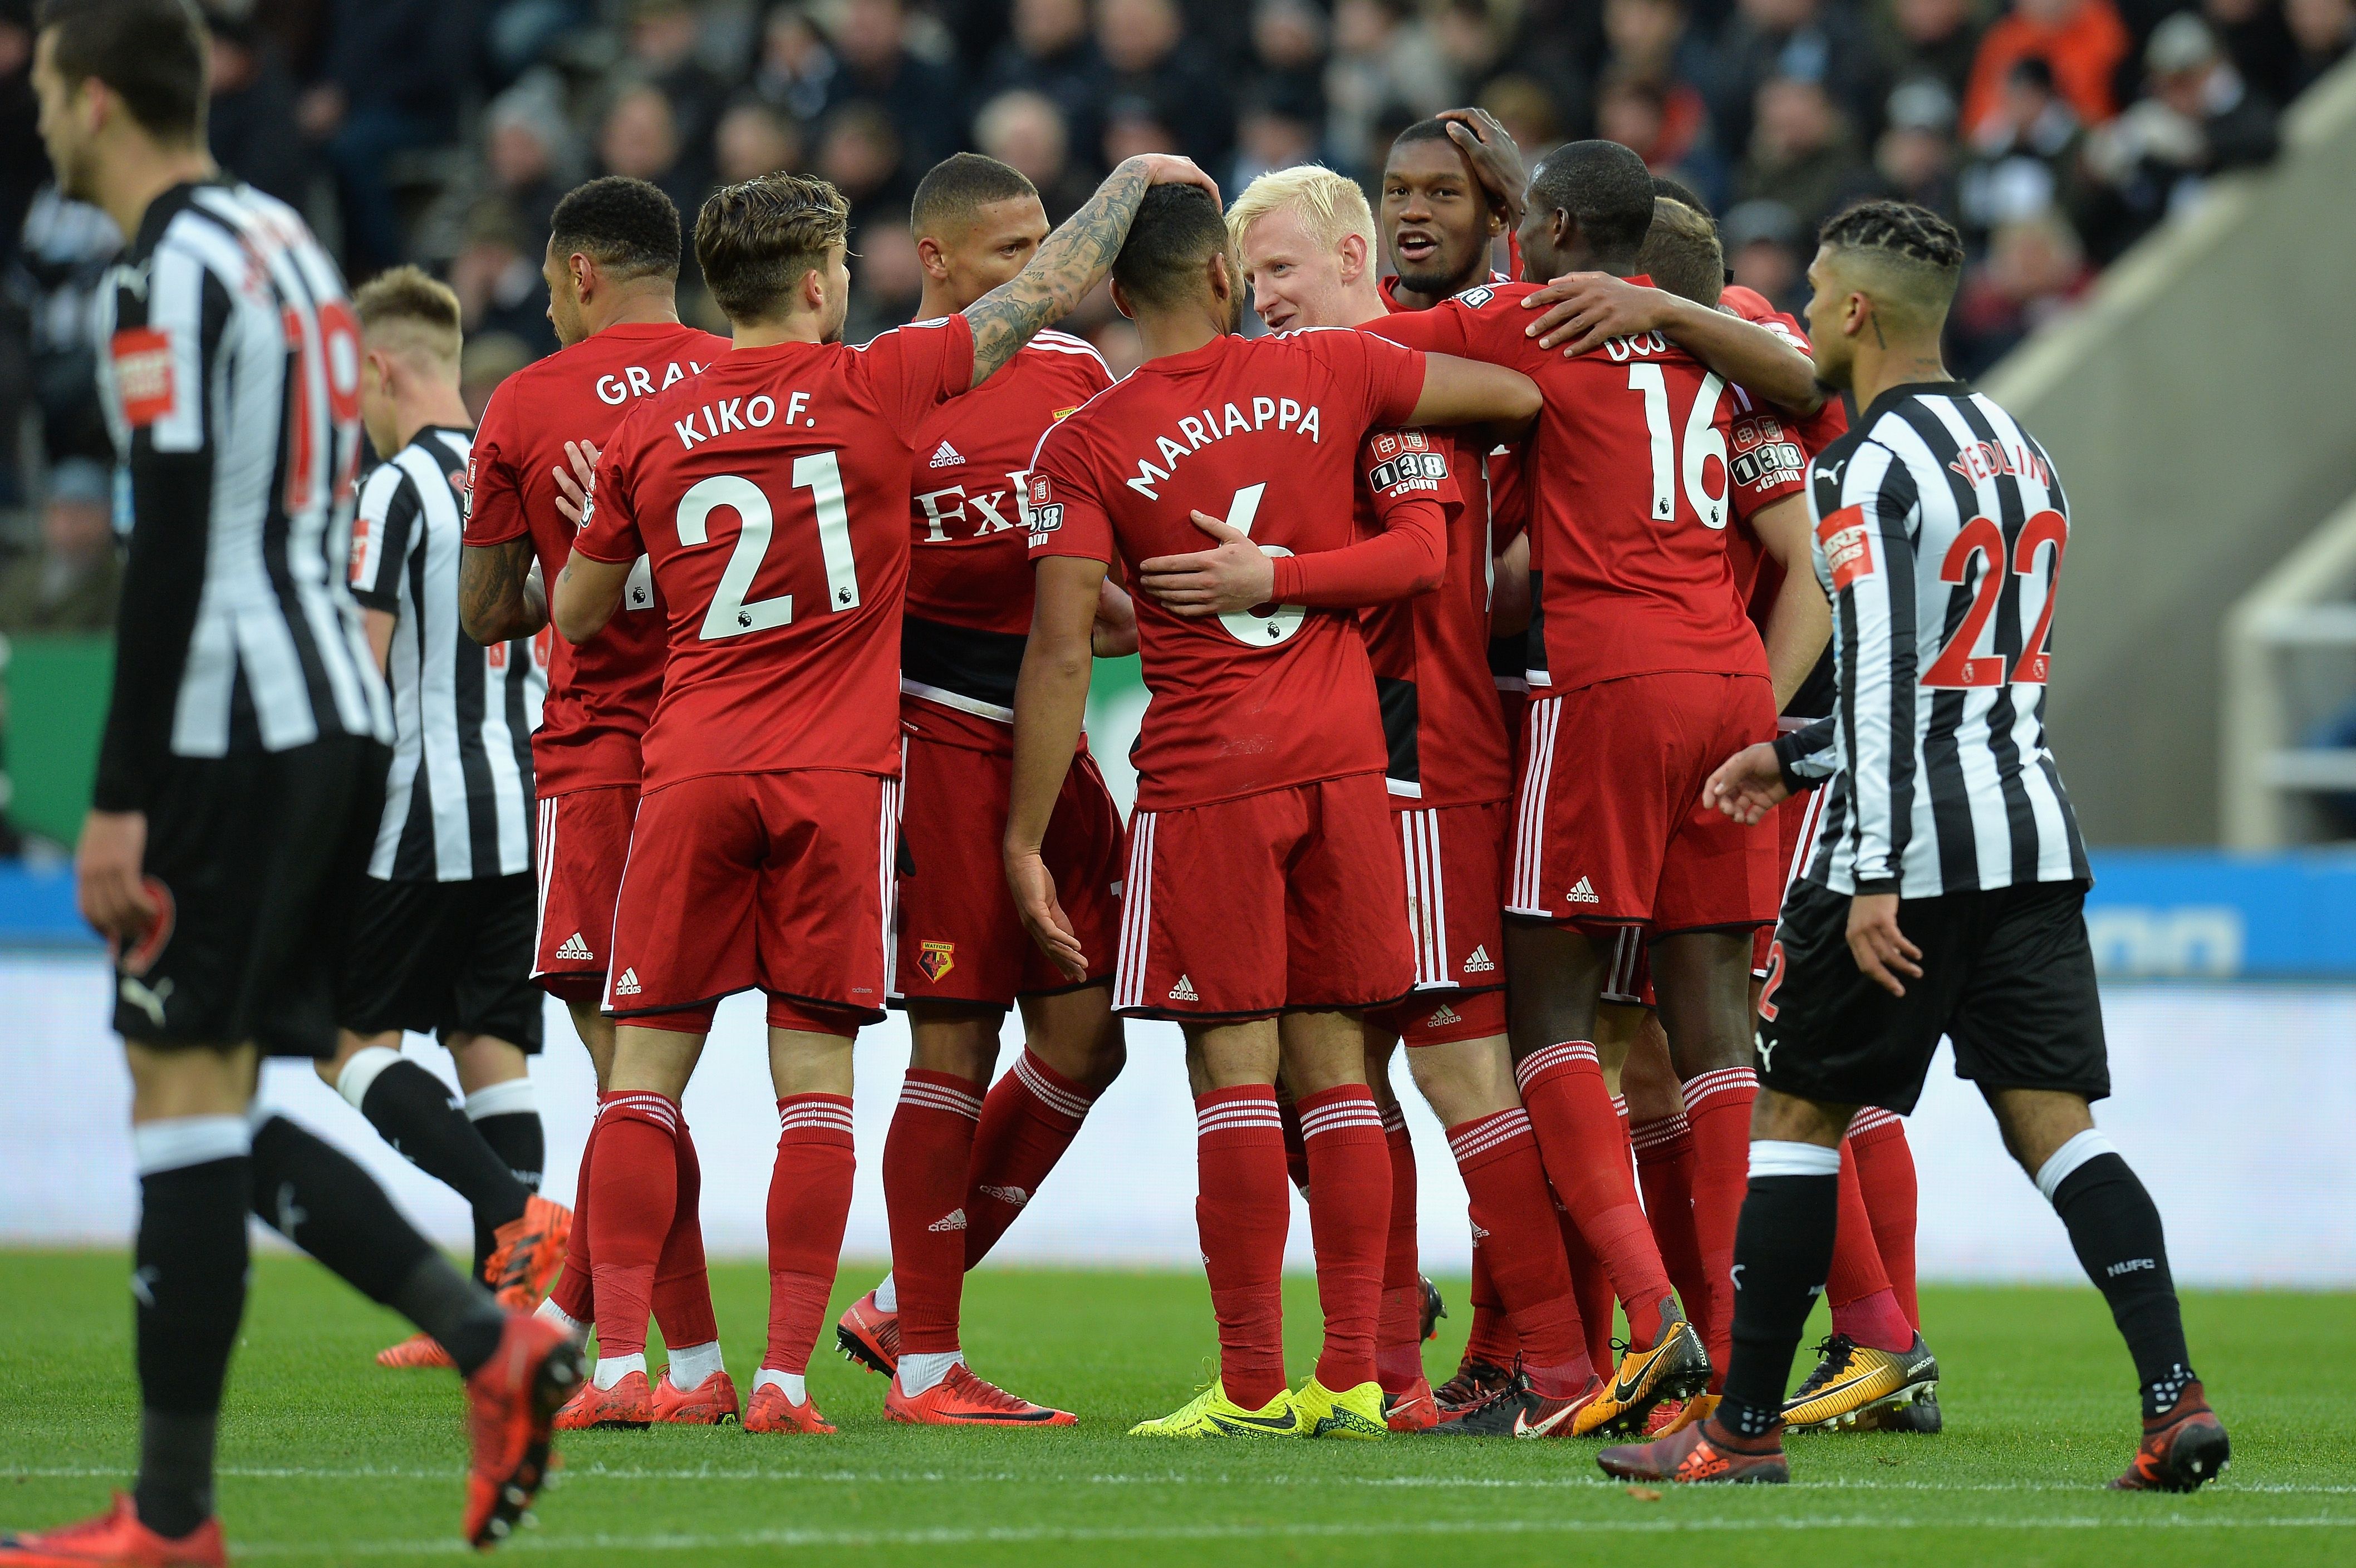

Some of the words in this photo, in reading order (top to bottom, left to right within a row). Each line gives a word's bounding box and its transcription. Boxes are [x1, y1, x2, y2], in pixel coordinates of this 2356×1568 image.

[674, 395, 776, 450] KIKO
[786, 391, 816, 428] F.
[1126, 396, 1320, 501] MARIAPPA
[1627, 362, 1729, 530] 16
[929, 454, 966, 468] adidas
[1374, 456, 1444, 486] 138
[1736, 446, 1801, 480] 138
[1948, 438, 2050, 491] YEDLIN
[1390, 478, 1438, 498] .com
[1755, 470, 1802, 493] .com
[676, 450, 861, 641] 21
[1920, 509, 2068, 690] 22
[1566, 892, 1599, 903] adidas
[556, 950, 593, 960] adidas
[1463, 961, 1495, 973] adidas
[616, 984, 642, 995] adidas
[1169, 990, 1199, 1001] adidas
[1427, 1015, 1461, 1027] adidas
